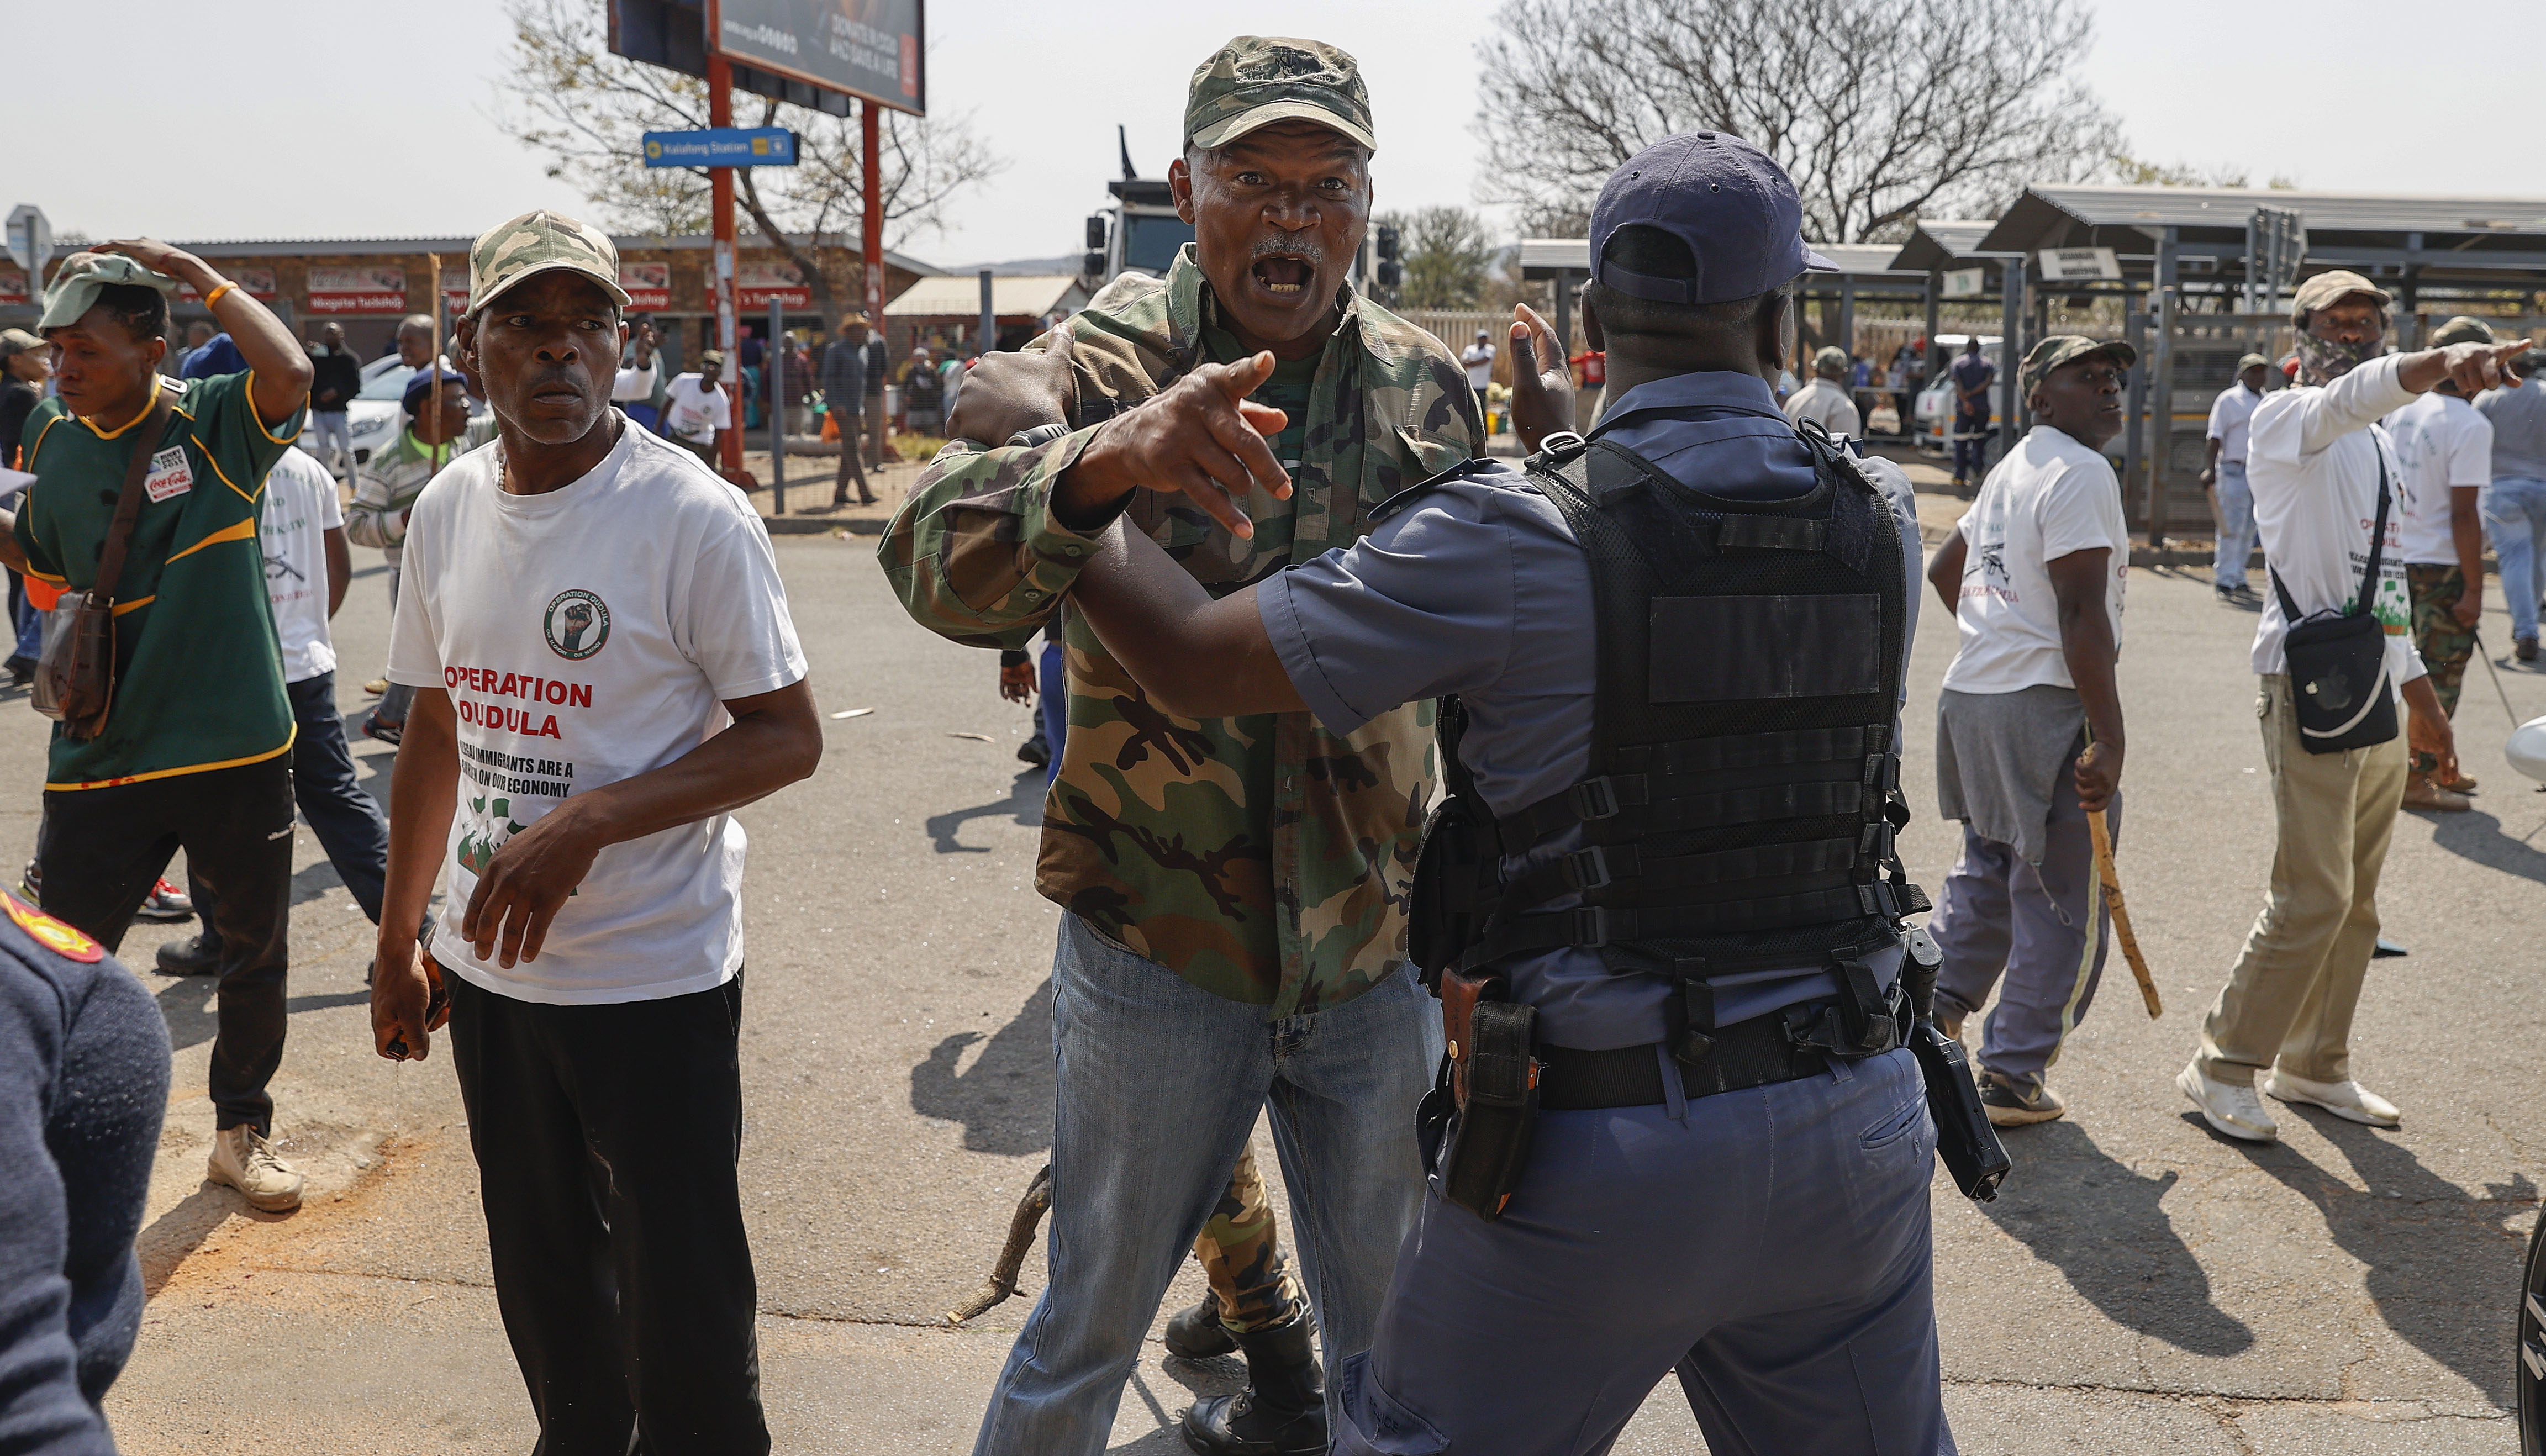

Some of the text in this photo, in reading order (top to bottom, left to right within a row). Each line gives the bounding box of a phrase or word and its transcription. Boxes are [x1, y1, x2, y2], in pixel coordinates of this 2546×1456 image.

[1237, 64, 1265, 74] COAST
[710, 141, 749, 155] Station
[549, 590, 609, 627] OPERATION DUDULA
[444, 666, 592, 708] OPERATION
[459, 700, 562, 740] DUDULA
[476, 747, 534, 774] IMMIGRANTS
[537, 759, 562, 777] ARE
[565, 762, 573, 778] A
[479, 769, 491, 787] ON
[492, 772, 507, 791] OUR
[507, 777, 571, 798] ECONOMY
